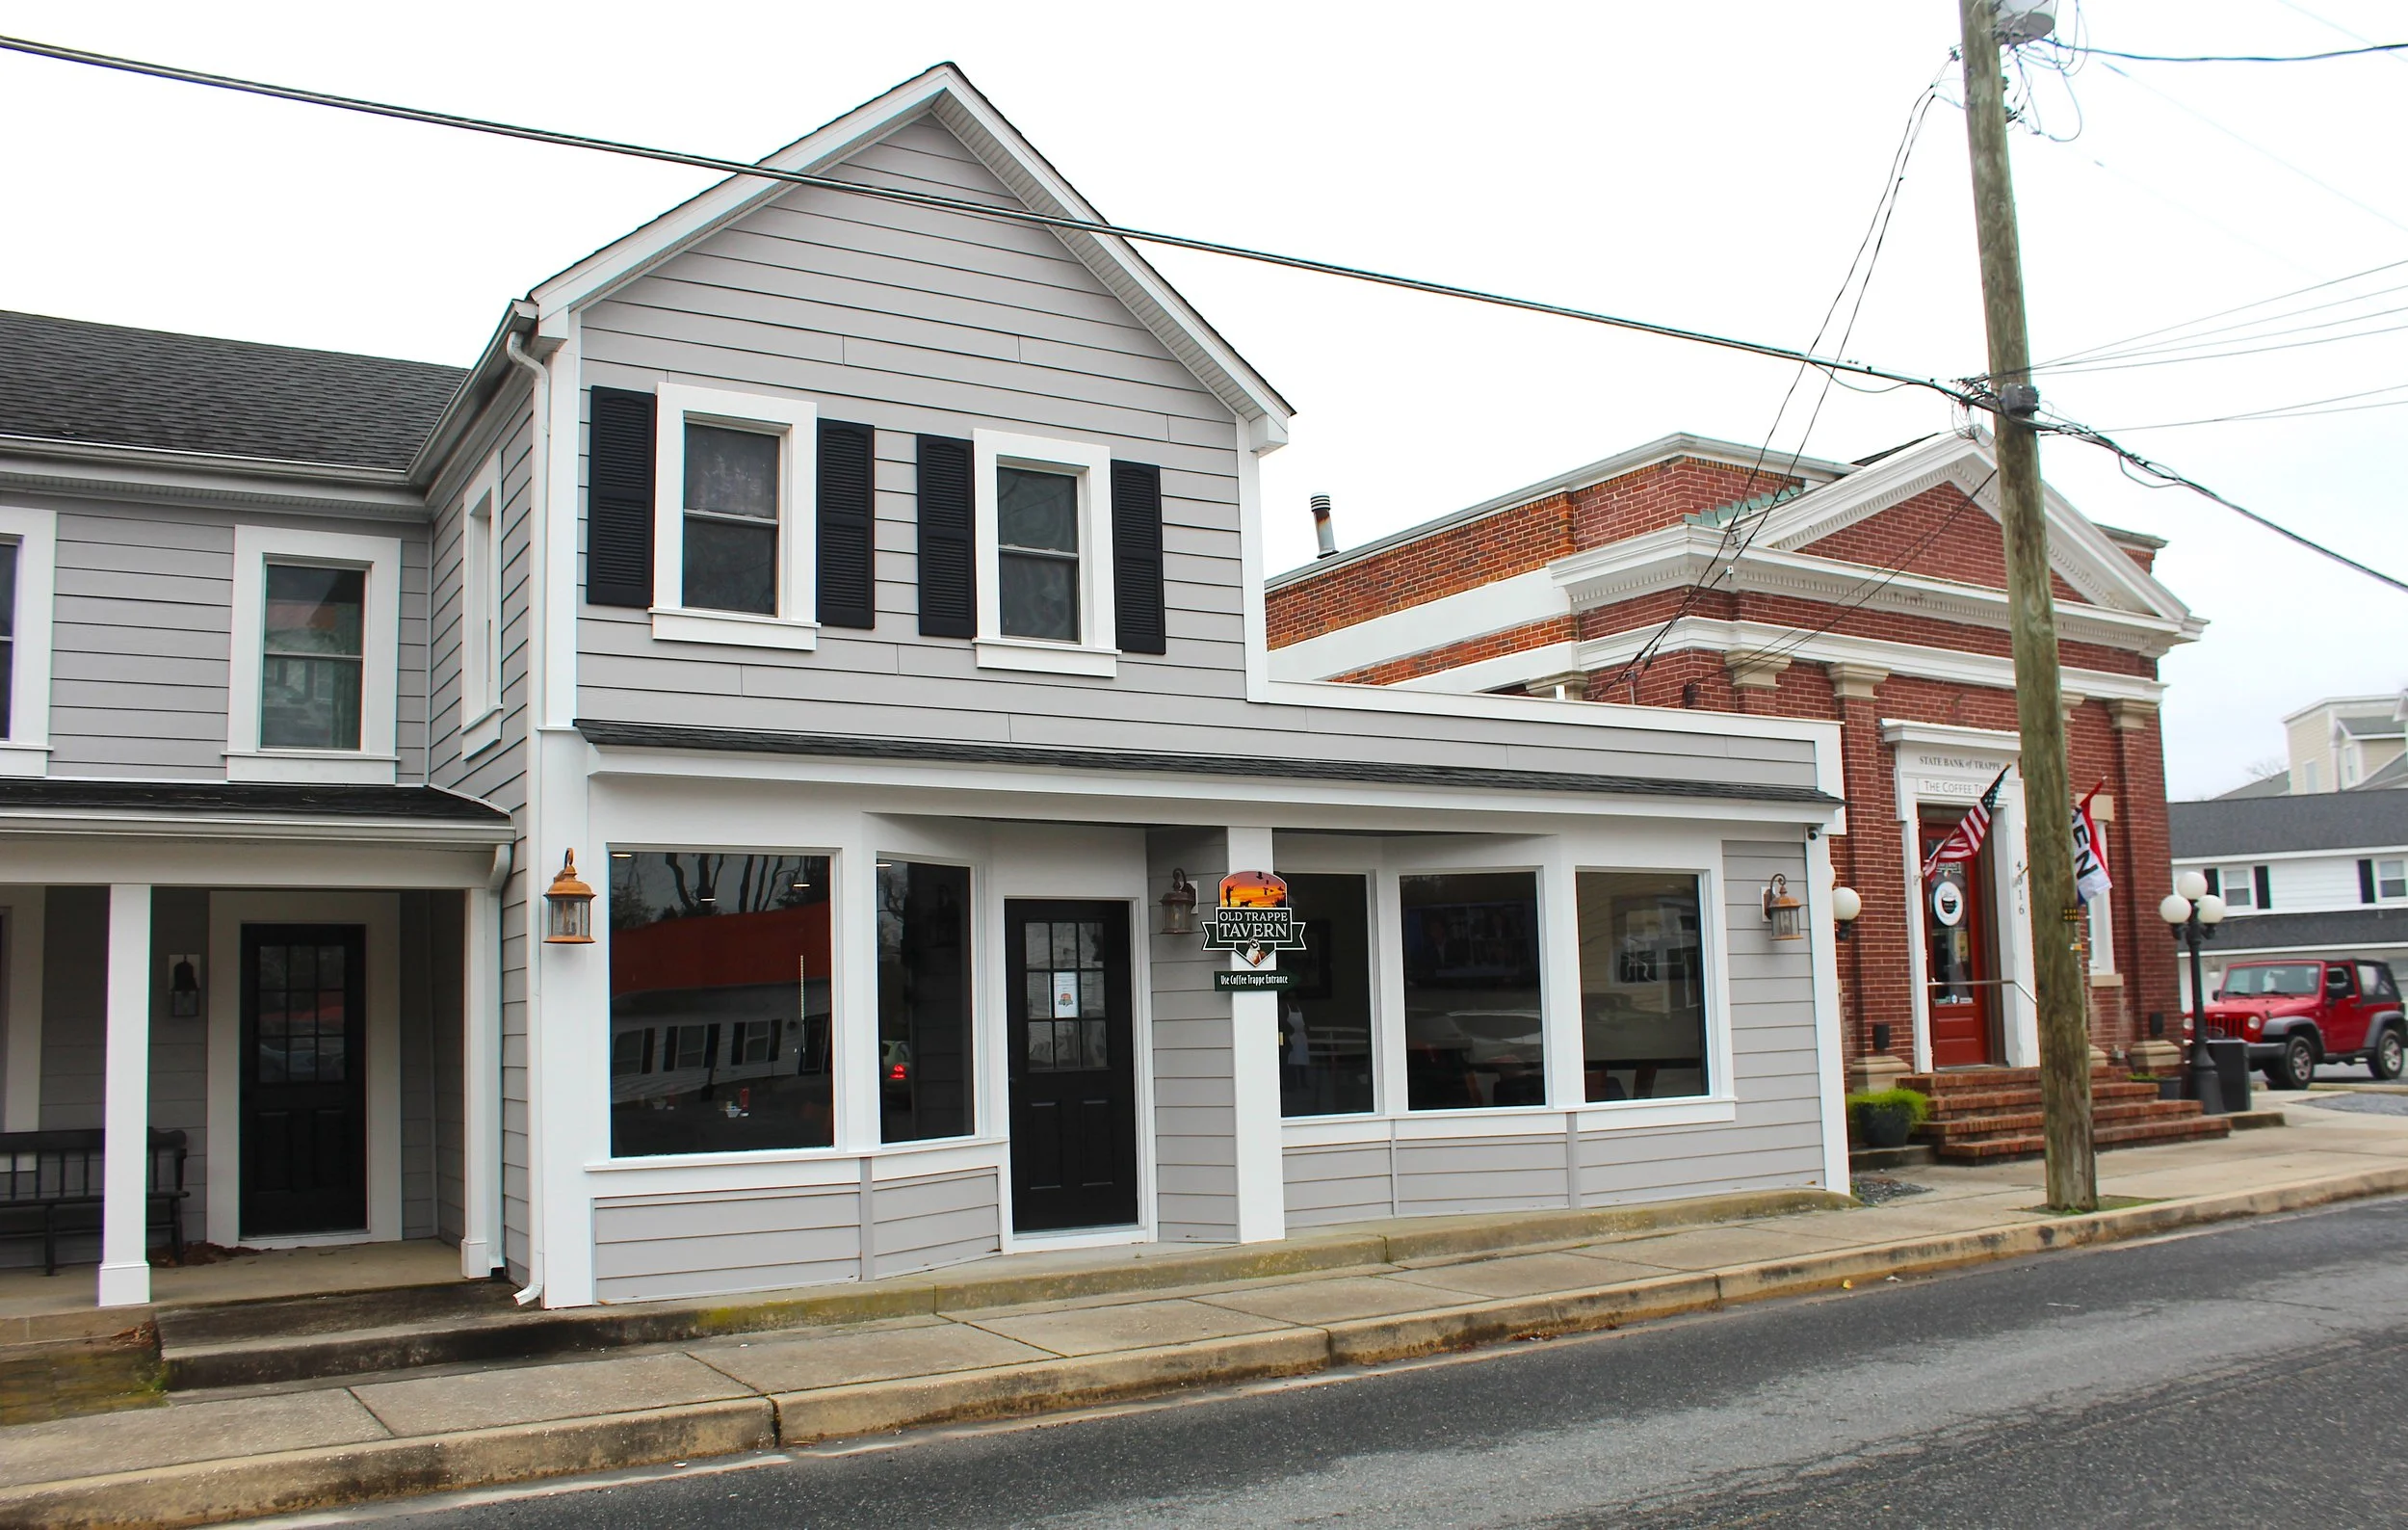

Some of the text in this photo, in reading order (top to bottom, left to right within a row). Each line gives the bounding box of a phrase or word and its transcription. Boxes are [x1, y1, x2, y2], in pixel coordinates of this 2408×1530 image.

[1920, 756, 2002, 771] STATE BANK of TRAPPE
[1924, 780, 1941, 792] THE
[1943, 781, 1973, 794] COFFEE
[1219, 911, 1288, 922] OLD TRAPPE
[1219, 923, 1287, 937] TAVERN
[1220, 974, 1289, 987] Use Coffee Trappe Entrance
